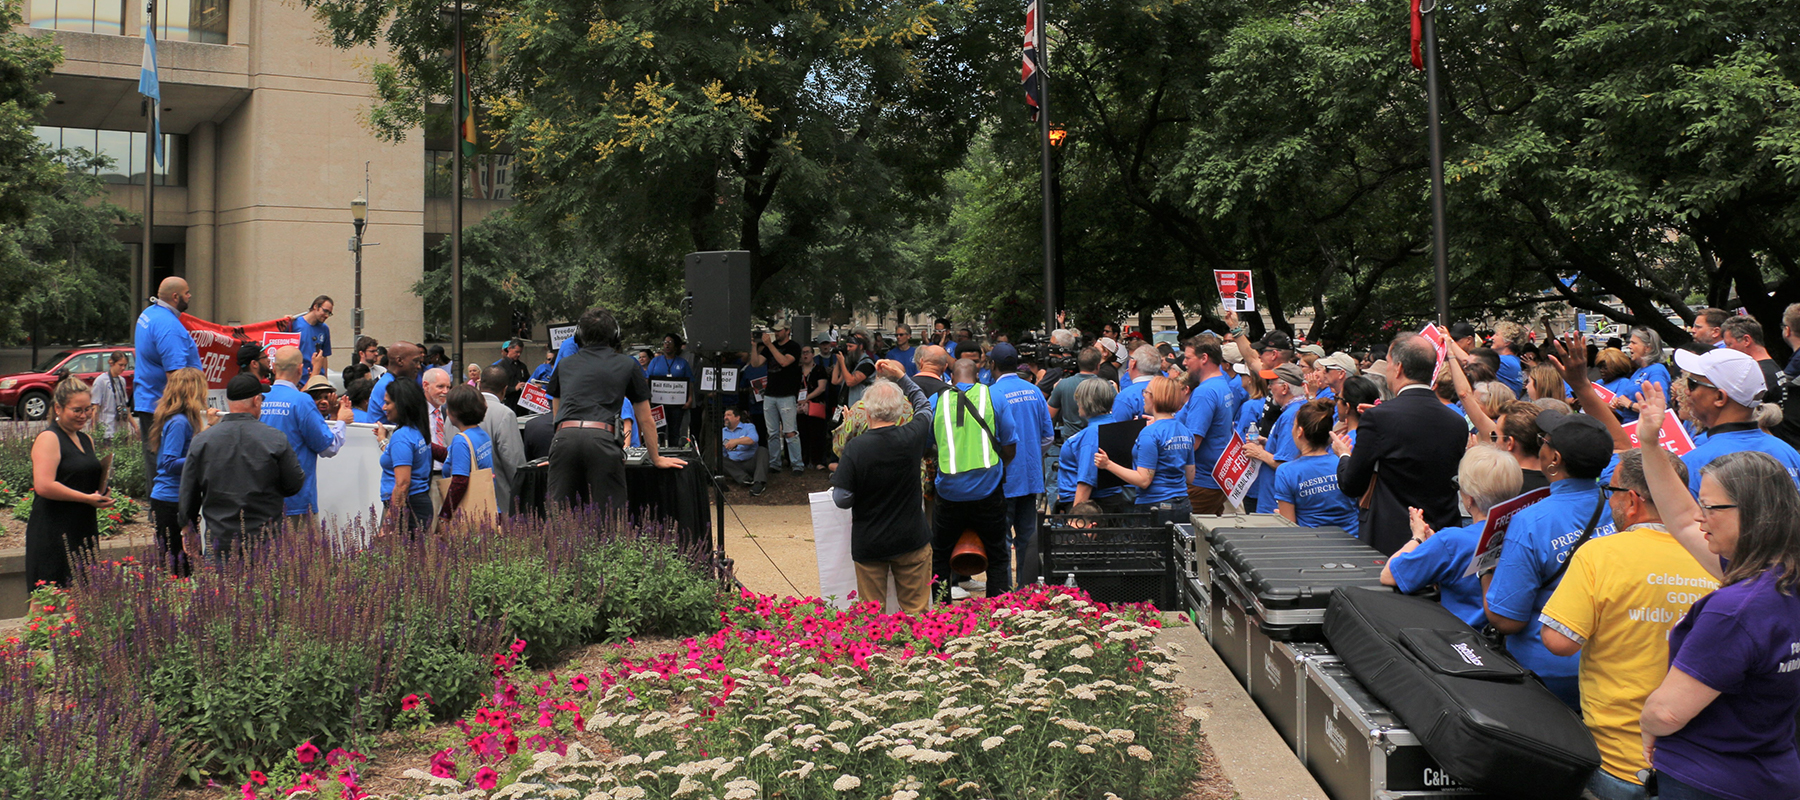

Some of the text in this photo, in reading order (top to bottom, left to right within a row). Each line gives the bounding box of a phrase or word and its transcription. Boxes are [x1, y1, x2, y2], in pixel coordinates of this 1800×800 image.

[203, 351, 231, 383] FREE
[1217, 455, 1234, 481] FREEDOM
[1231, 487, 1241, 500] THE
[1237, 477, 1248, 491] BAIL
[1299, 483, 1336, 498] CHURCH
[1628, 607, 1674, 623] wildly
